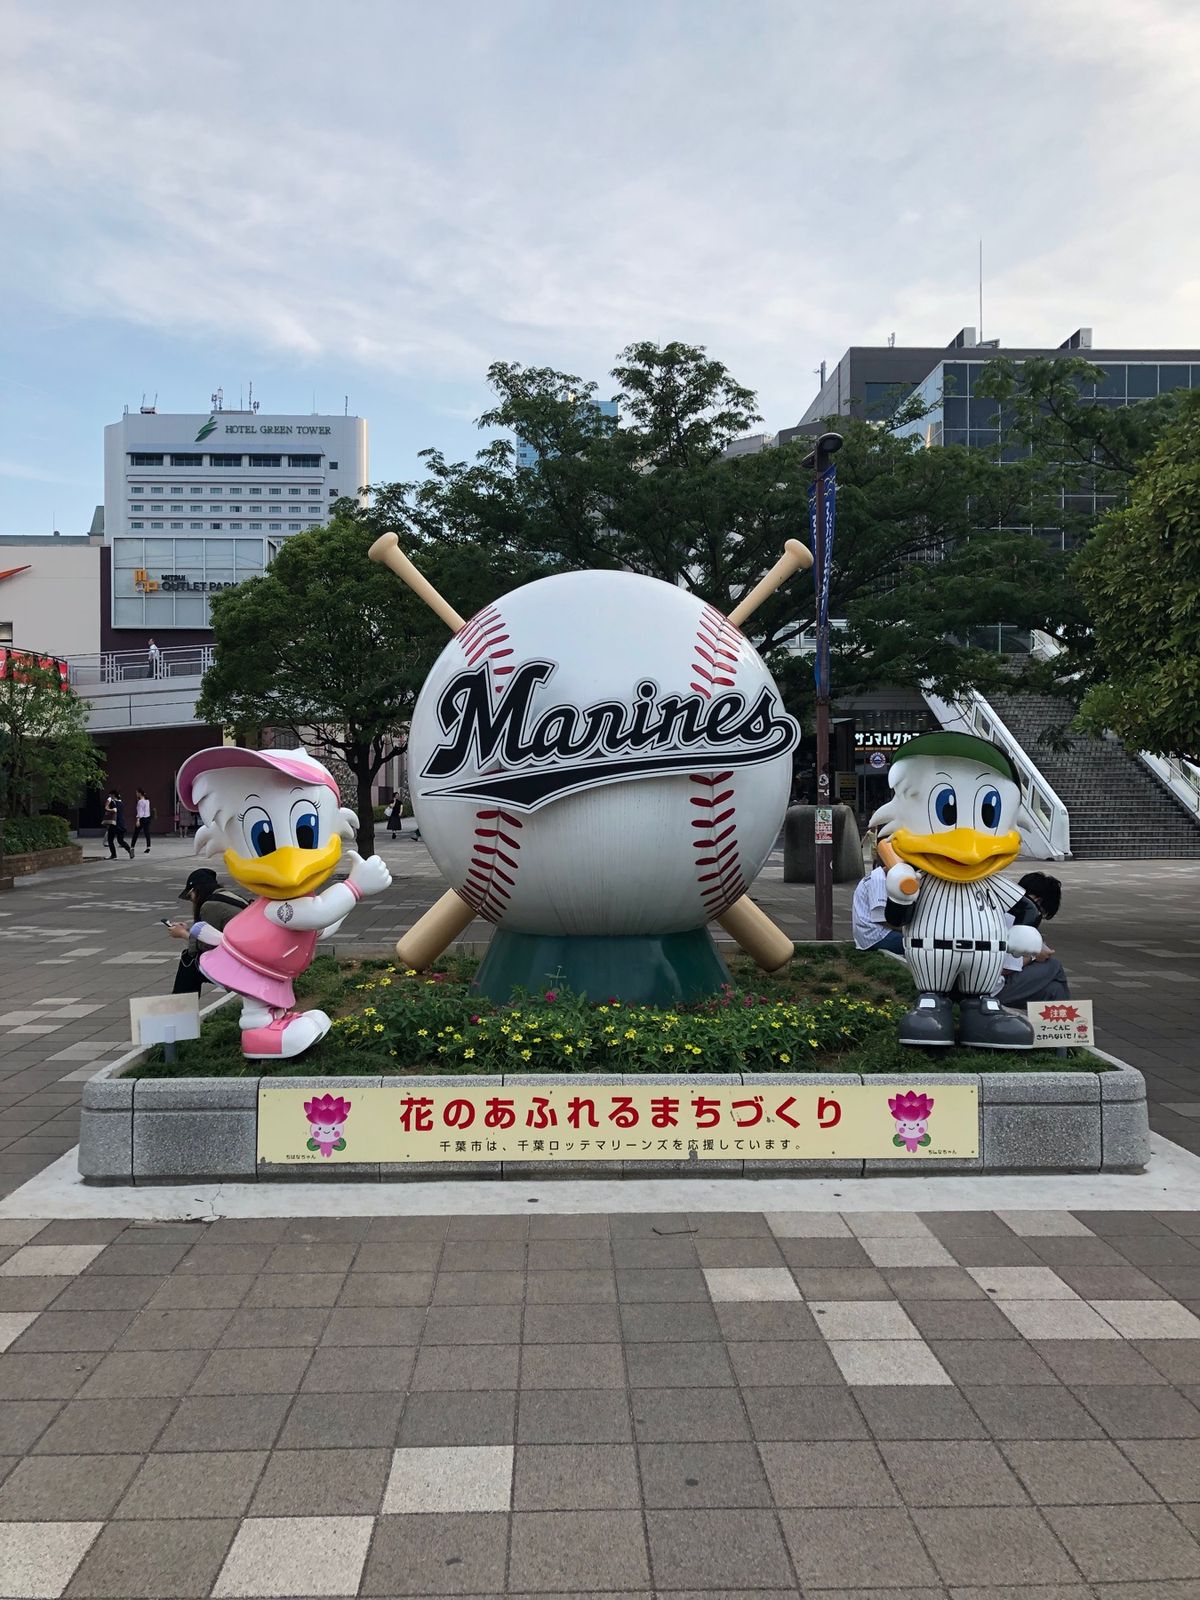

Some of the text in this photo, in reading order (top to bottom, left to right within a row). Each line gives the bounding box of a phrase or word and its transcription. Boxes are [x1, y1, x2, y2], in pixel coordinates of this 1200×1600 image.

[225, 425, 331, 435] HOTEL GREEN TOWER
[162, 582, 206, 591] OUTLET
[420, 660, 795, 779] Marines
[854, 733, 920, 745] サンマルクカ
[400, 1096, 842, 1131] 花のあふれるまちづくり
[440, 1138, 801, 1153] 千葉市は、千葉ロッテマリーンズを応援しています。
